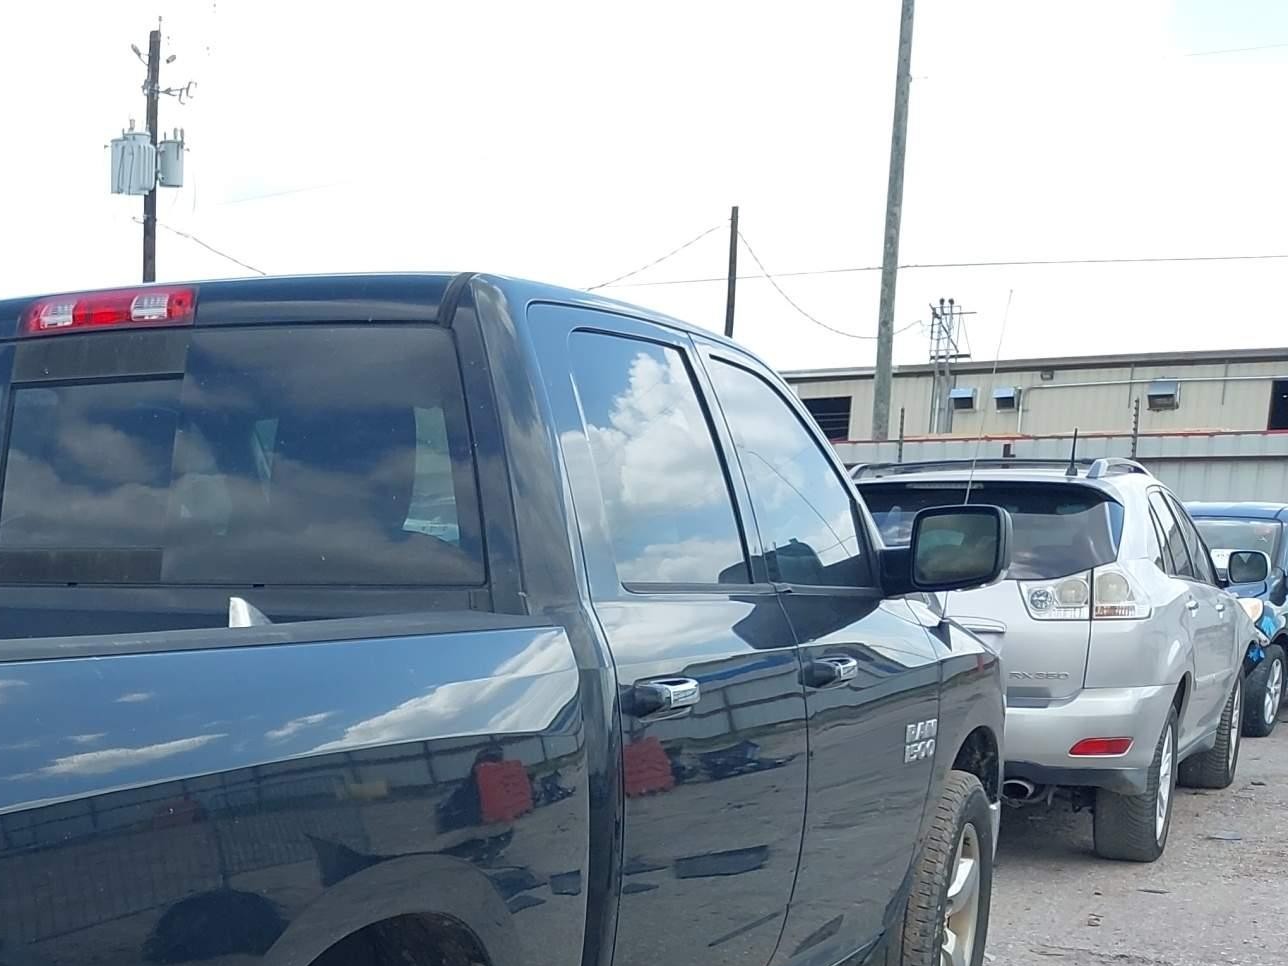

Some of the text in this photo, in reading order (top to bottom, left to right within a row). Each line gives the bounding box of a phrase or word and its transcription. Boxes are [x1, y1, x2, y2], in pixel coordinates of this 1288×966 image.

[1008, 671, 1071, 681] RX 350
[905, 718, 938, 744] RAM
[904, 738, 936, 763] 1500
